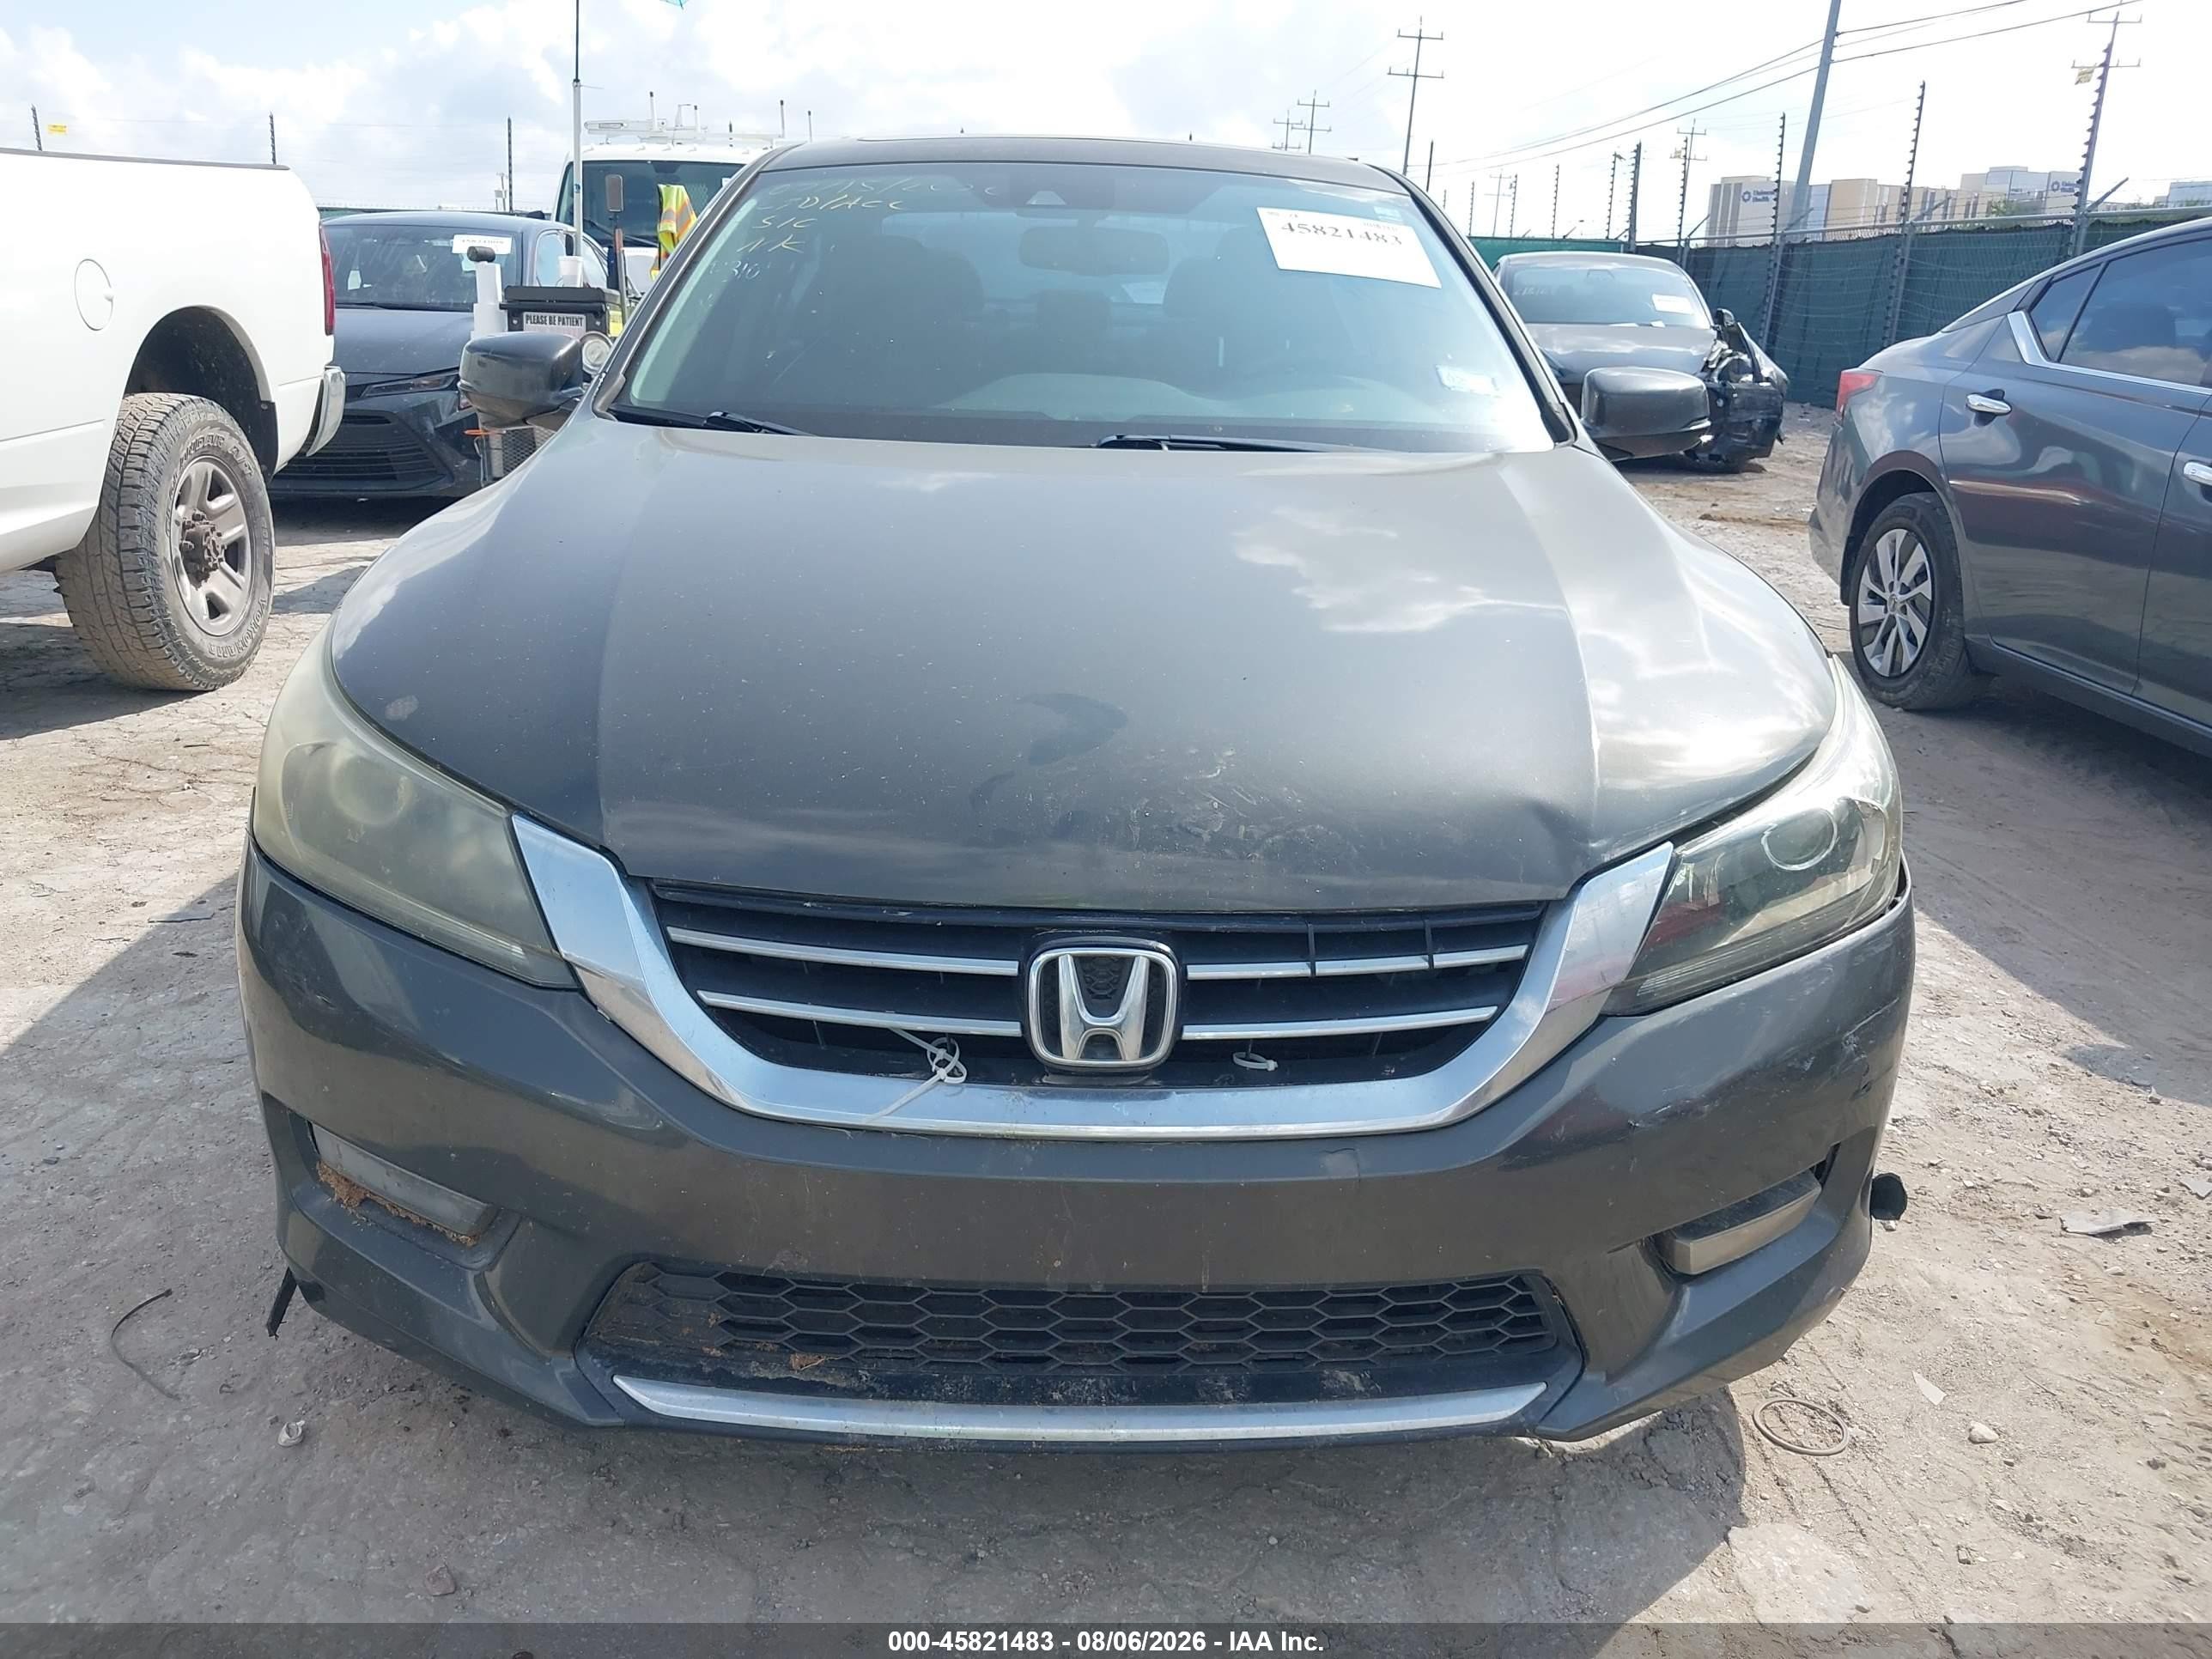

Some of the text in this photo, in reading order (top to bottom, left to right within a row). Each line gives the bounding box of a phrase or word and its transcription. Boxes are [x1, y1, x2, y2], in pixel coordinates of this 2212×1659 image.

[1280, 222, 1403, 246] 45821483
[526, 314, 584, 327] PLEASE BE PATIENT
